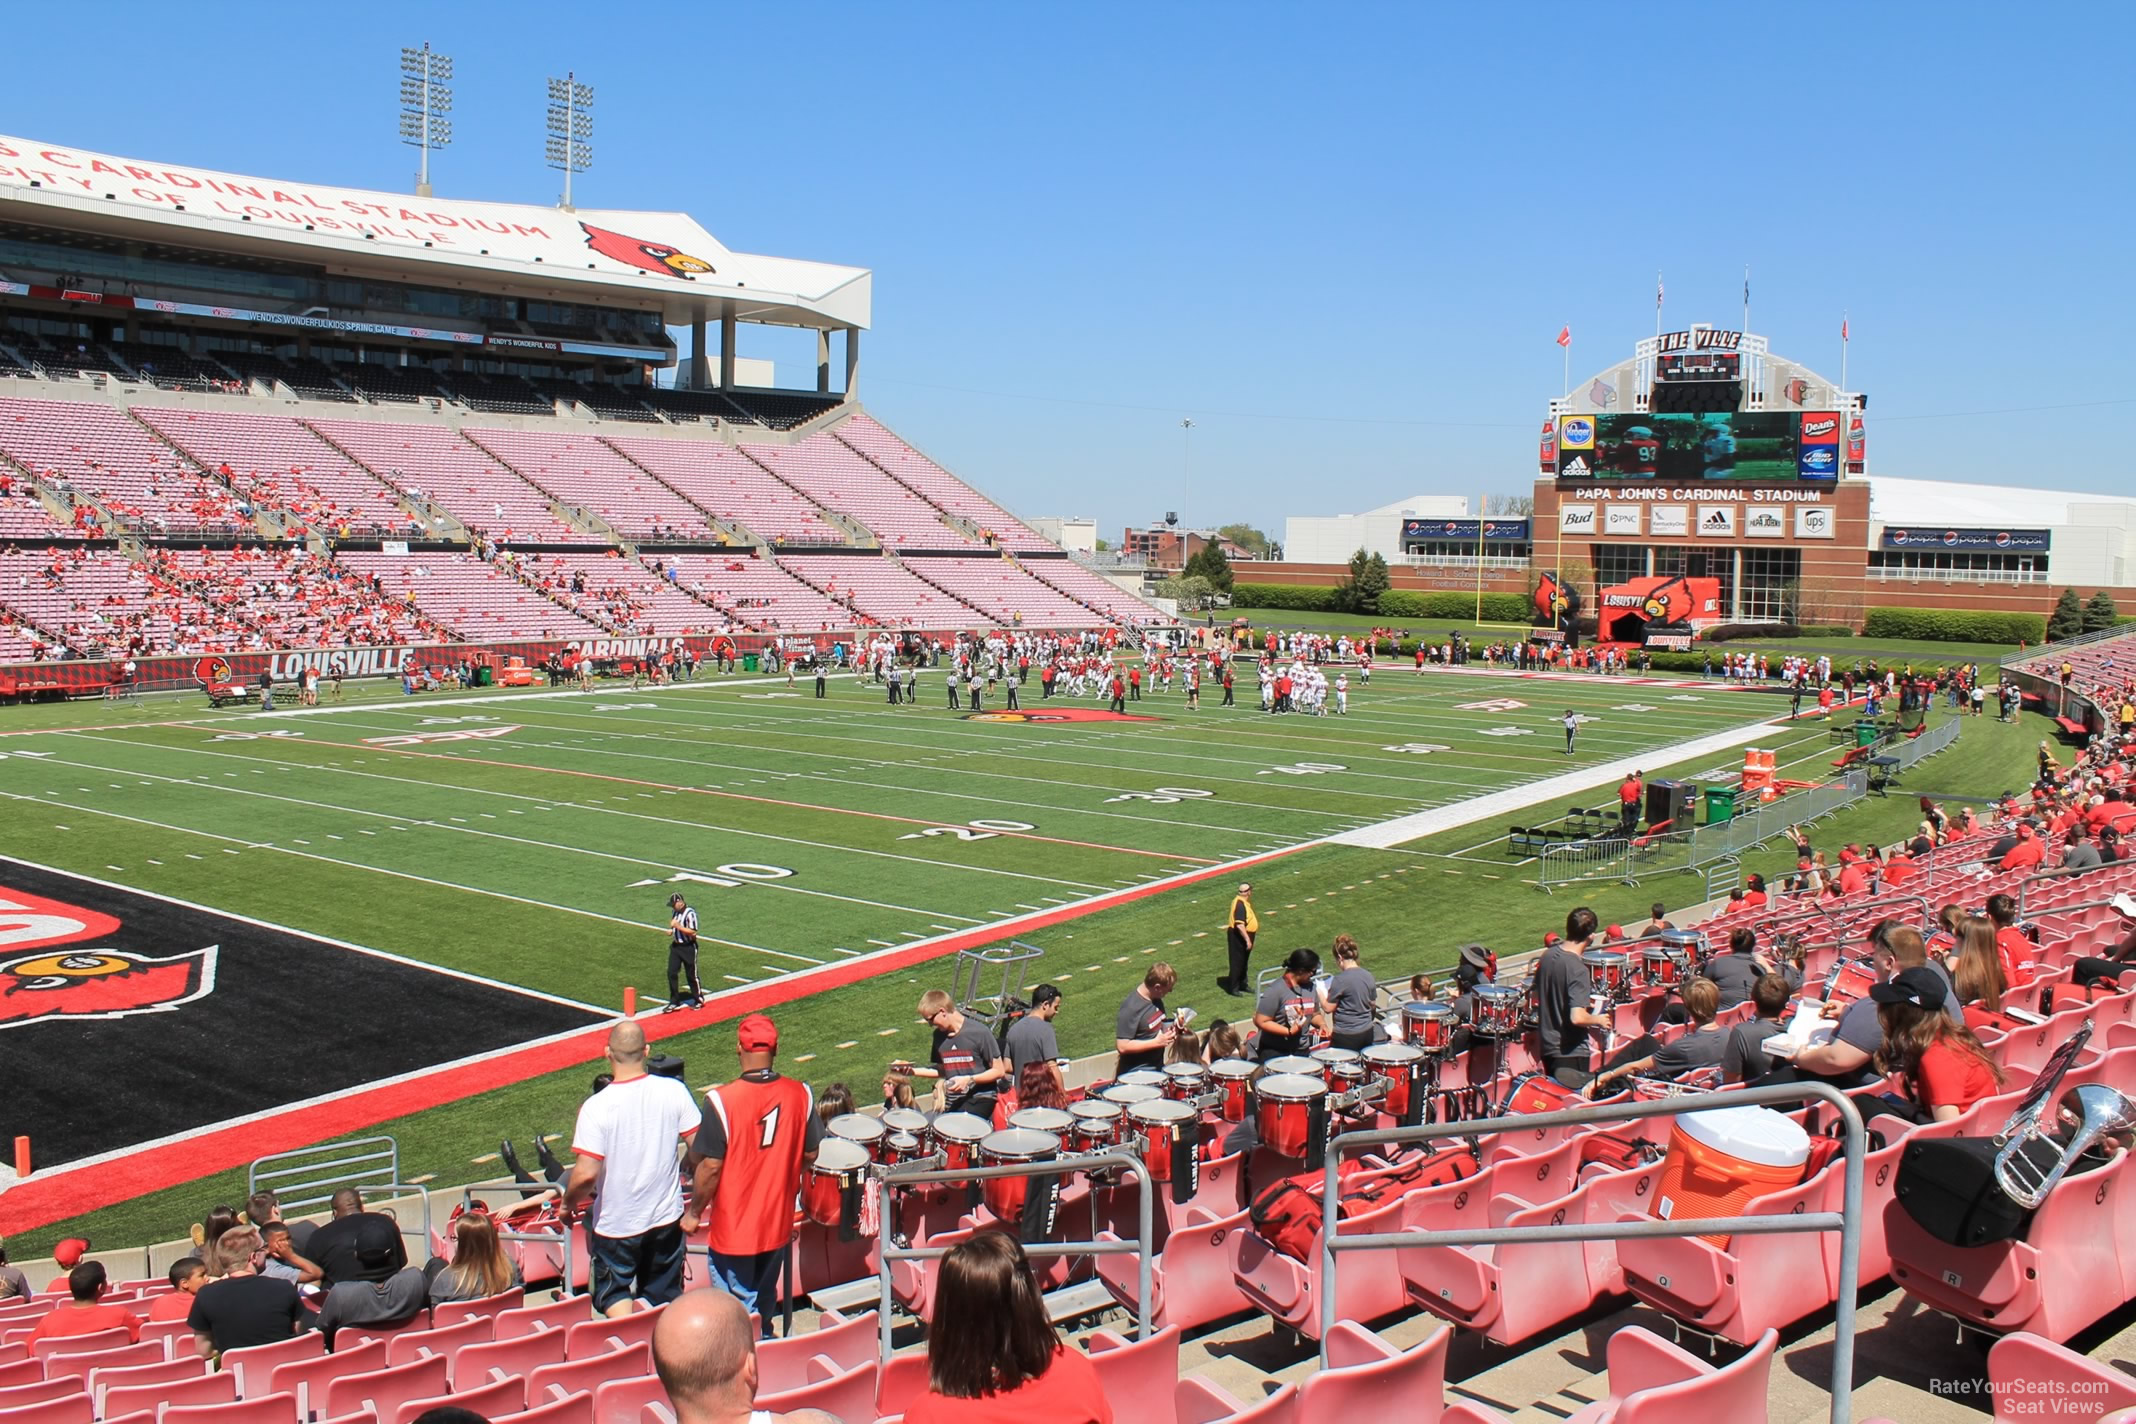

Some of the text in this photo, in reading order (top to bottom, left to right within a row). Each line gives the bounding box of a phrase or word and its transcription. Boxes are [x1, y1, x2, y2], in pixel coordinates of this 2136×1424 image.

[40, 151, 335, 211] CARDINAL
[341, 200, 552, 240] STADIUM
[132, 188, 187, 205] OF
[214, 200, 456, 244] LOUISVILLE
[250, 311, 397, 335] WENDY'S WONDERFUL KIDS SPRING GAME
[488, 337, 557, 350] WENDY'S WONDERFUL KIDS
[1660, 330, 1741, 351] THE VILLE
[1566, 424, 1590, 441] Kroger
[1805, 419, 1836, 434] Dean's
[1562, 467, 1592, 476] adidas
[1575, 487, 1821, 502] PAPA JOHN'S CARDINAL STADIUM
[1564, 511, 1593, 525] Bud
[1620, 515, 1637, 523] PNC
[1807, 517, 1824, 529] ups
[1420, 524, 1442, 534] pepsi
[1457, 525, 1480, 535] pepsi
[1495, 526, 1520, 535] pepsi
[1703, 522, 1731, 530] adidas
[1909, 533, 1938, 544] pepsi
[1959, 534, 1989, 545] pepsi
[2011, 535, 2043, 546] pepsi
[1416, 569, 1442, 577] Howard
[1431, 580, 1458, 588] Football
[785, 636, 812, 647] planet
[1647, 636, 1692, 646] LOUISVILLE
[1272, 762, 1348, 775] 40
[1119, 787, 1215, 803] 30
[922, 820, 1036, 841] 20
[665, 863, 793, 887] 10
[758, 1105, 782, 1149] 1
[1191, 1143, 1199, 1161] VIC
[1050, 1182, 1060, 1201] VIC
[1659, 1276, 1668, 1287] Q
[1948, 1273, 1958, 1285] R
